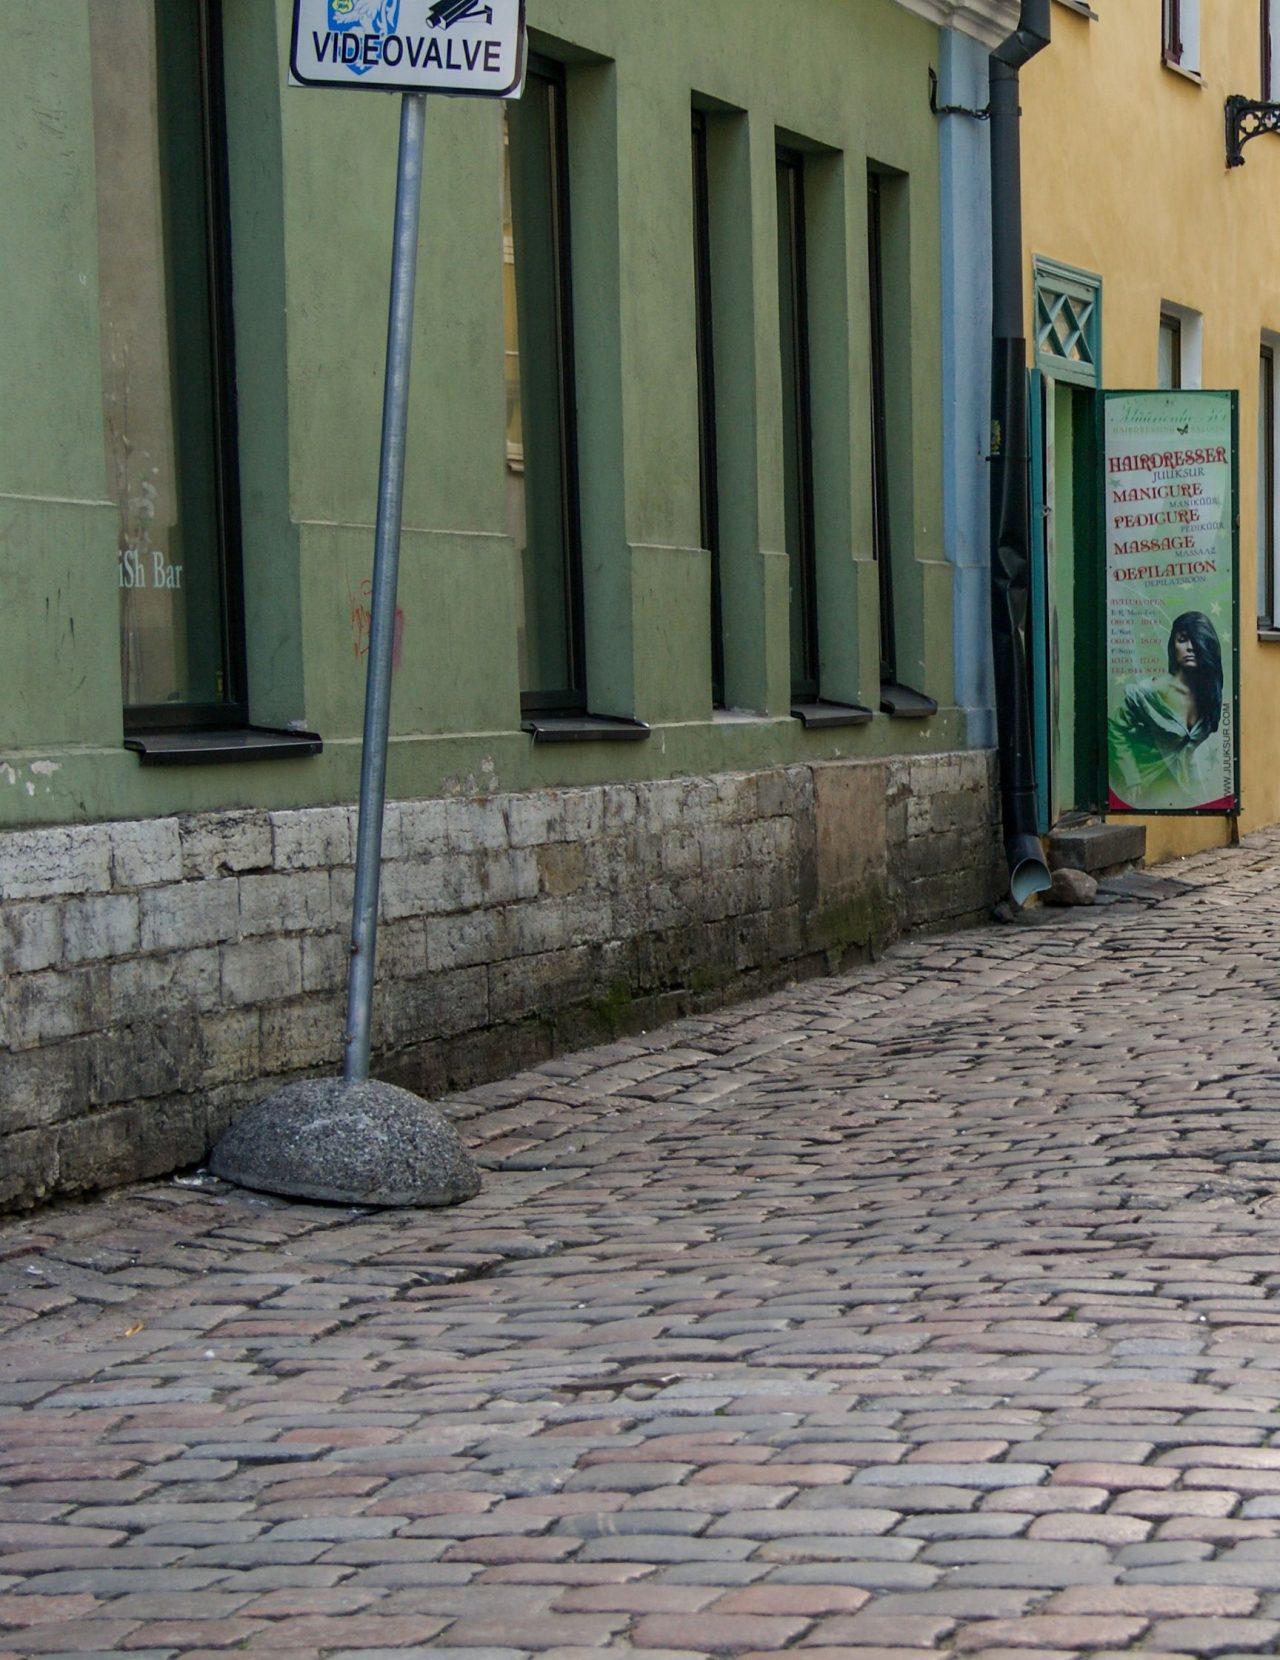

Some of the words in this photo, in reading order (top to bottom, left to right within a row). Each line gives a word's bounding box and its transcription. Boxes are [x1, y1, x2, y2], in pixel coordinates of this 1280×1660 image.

[312, 31, 502, 73] VIDEOVALVE
[1108, 446, 1228, 473] HAIRDRESSER
[1152, 467, 1206, 483] JUUKSUR
[1114, 535, 1196, 555] MASSAGE
[152, 551, 182, 588] Bar
[1112, 560, 1217, 582] DEPILATION
